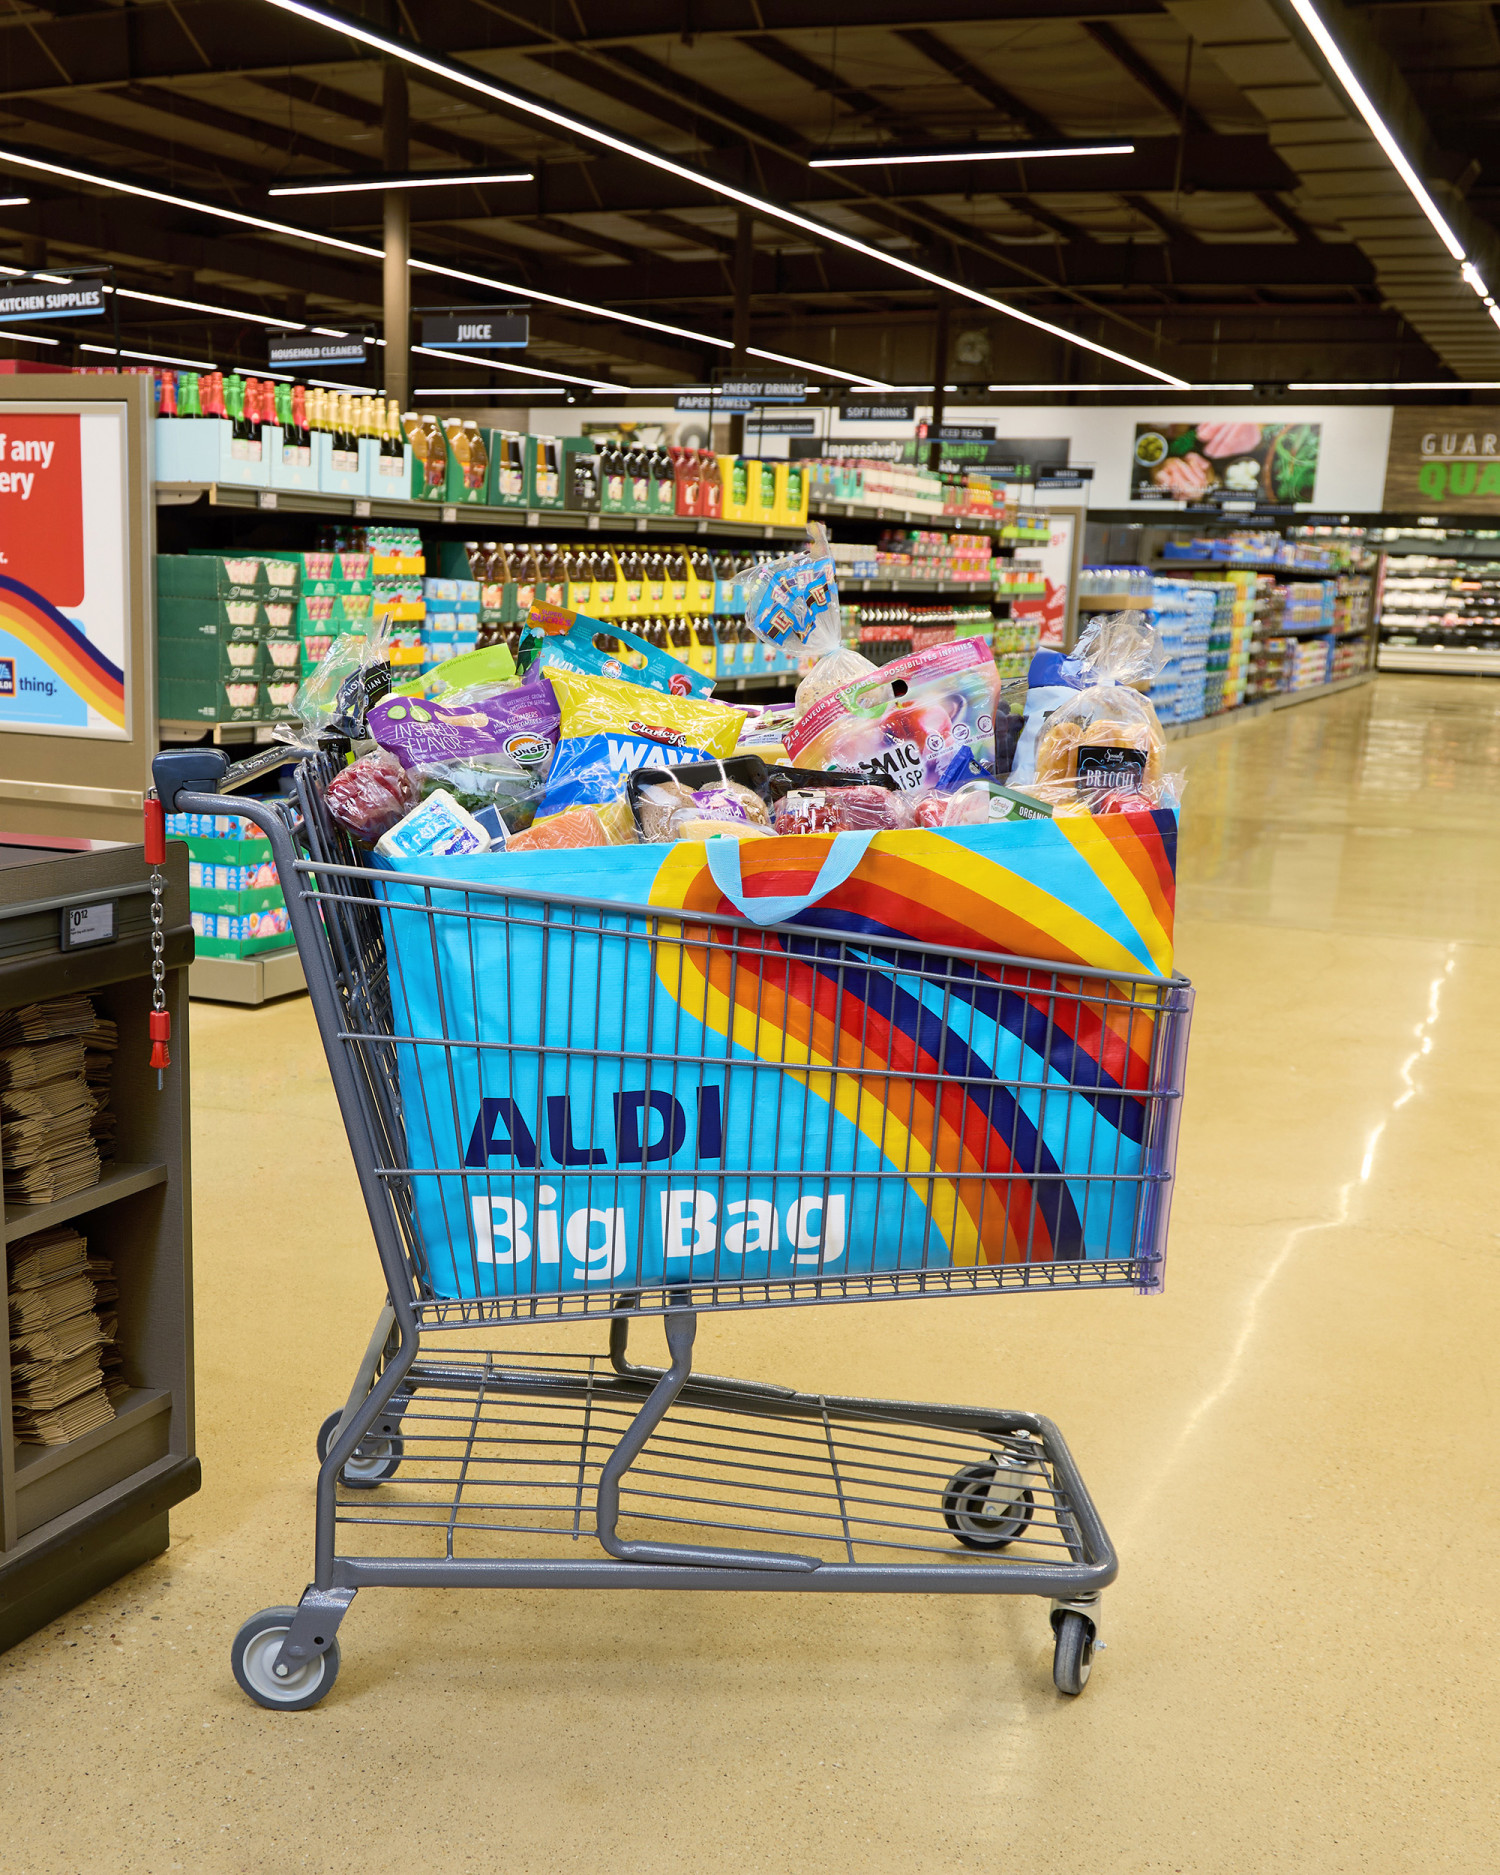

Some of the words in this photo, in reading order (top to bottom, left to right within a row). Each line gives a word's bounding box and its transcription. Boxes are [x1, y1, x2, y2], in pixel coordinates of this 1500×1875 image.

[0, 296, 45, 312] KITCHEN
[46, 291, 100, 309] SUPPLIES
[457, 324, 492, 342] JUICE
[271, 347, 320, 359] HOUSEHOLD
[321, 344, 363, 356] CLEANERS
[723, 383, 763, 396] ENERGY
[764, 383, 804, 395] DRINKS
[678, 397, 711, 408] PAPER
[712, 397, 751, 408] TOWELS
[846, 407, 871, 418] SOFT
[872, 406, 908, 418] DRINKS
[940, 429, 960, 438] ICED
[961, 428, 983, 438] TEAS
[11, 440, 55, 469] any
[822, 440, 904, 462] Impressively
[19, 677, 57, 696] thing.
[801, 701, 827, 727] SAVEUR
[395, 722, 460, 740] INSPIRED
[509, 743, 552, 758] SUNSET
[465, 1085, 721, 1168] ALDI
[471, 1185, 627, 1280] Big
[660, 1188, 846, 1265] Bag
